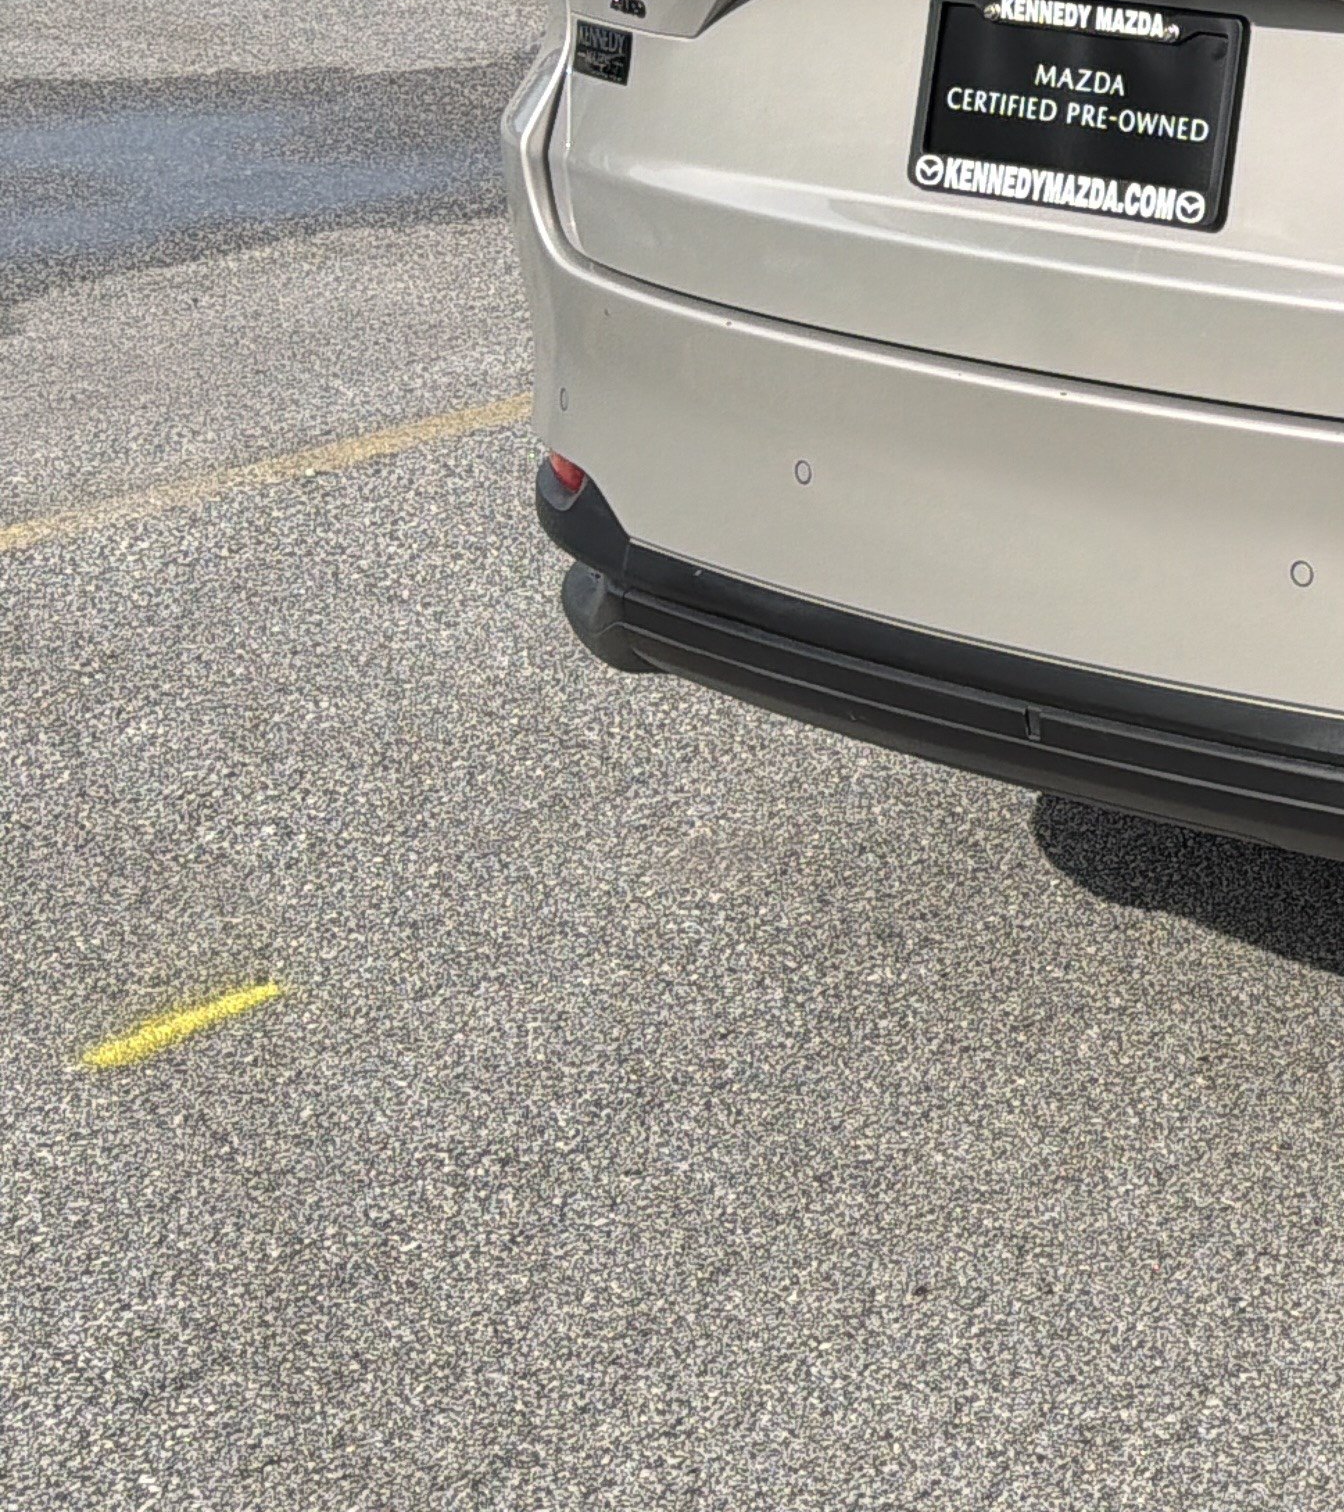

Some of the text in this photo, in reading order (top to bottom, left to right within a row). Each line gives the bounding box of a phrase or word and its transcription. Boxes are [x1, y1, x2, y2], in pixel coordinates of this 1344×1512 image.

[1095, 5, 1165, 38] MAZDA
[1034, 64, 1125, 96] MAZDA
[947, 87, 1210, 142] CERTIFIED PRE-OWNED
[943, 156, 1178, 221] KENNEDYMAZDA.COM
